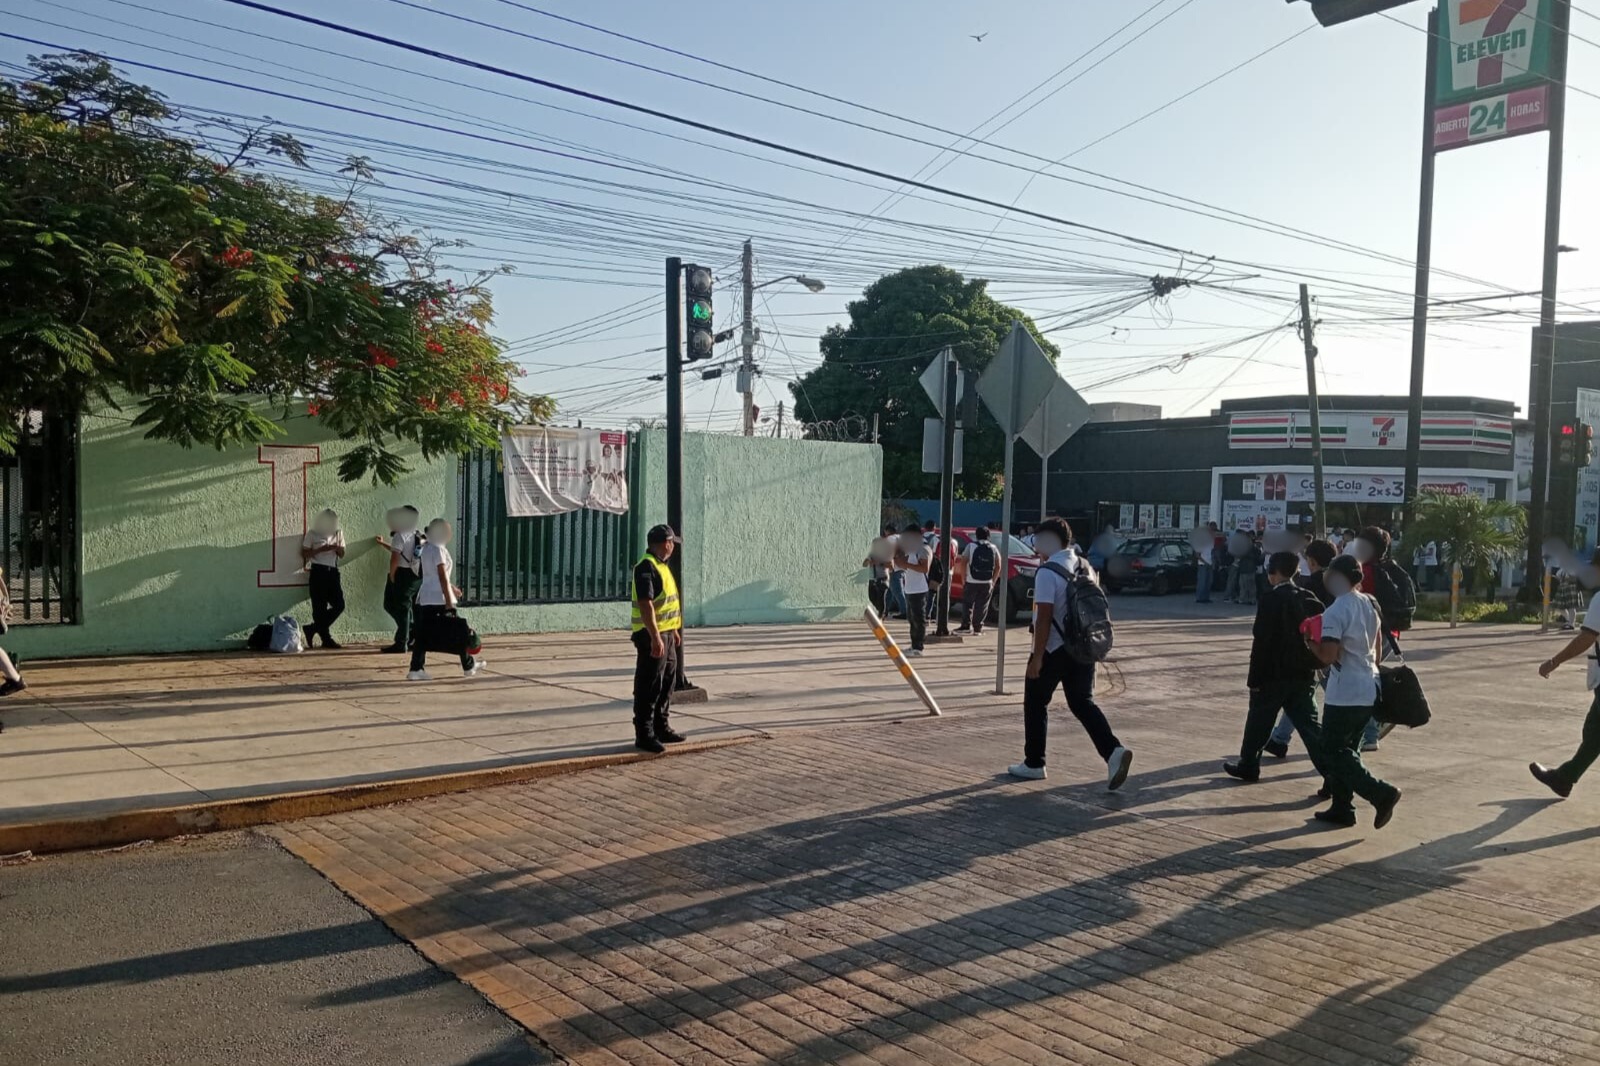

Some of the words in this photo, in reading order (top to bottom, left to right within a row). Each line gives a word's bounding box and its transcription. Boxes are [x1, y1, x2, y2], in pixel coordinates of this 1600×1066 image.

[1459, 0, 1527, 88] 7
[1435, 117, 1468, 134] ABIERTO
[1469, 100, 1506, 136] 24
[1510, 101, 1541, 118] HORAS
[1372, 417, 1395, 446] 7
[1300, 479, 1362, 491] Coa-Cola
